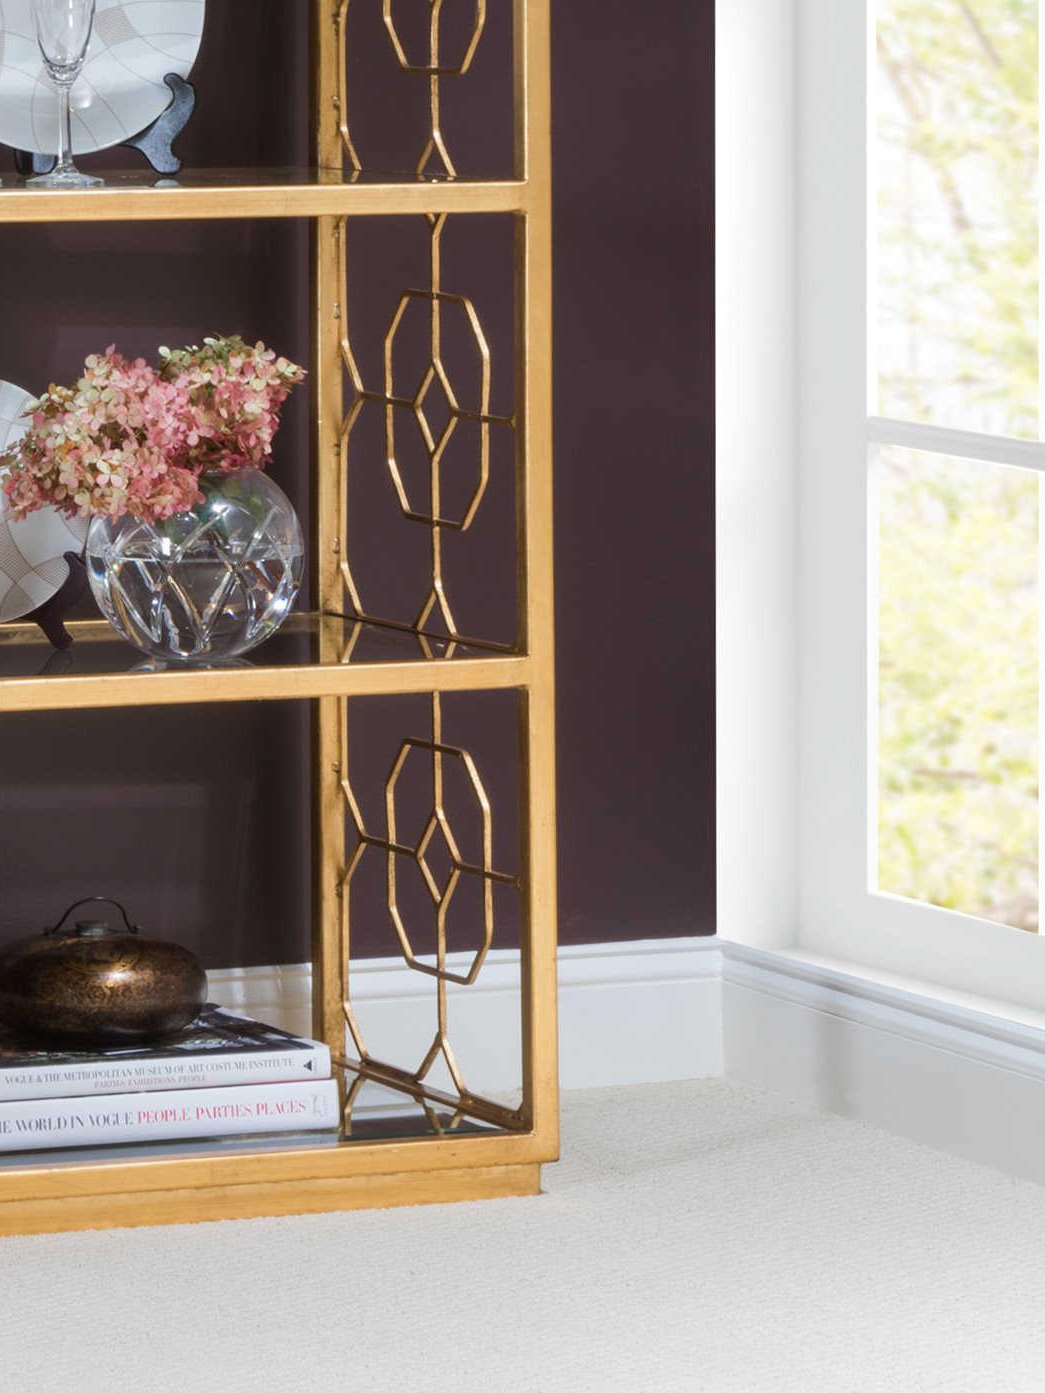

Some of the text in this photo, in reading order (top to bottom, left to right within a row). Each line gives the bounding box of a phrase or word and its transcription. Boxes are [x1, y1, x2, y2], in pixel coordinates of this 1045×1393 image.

[5, 1075, 35, 1085] VOGUE
[44, 1072, 61, 1083] THE
[63, 1068, 132, 1081] METROPOLITAN
[134, 1064, 172, 1077] MUSEUM
[173, 1063, 185, 1073] OF
[188, 1063, 205, 1073] ART
[206, 1060, 248, 1072] COSTUME
[249, 1057, 293, 1069] INSTITUTE
[14, 1116, 68, 1132] WORLD
[70, 1114, 86, 1128] IN
[88, 1111, 134, 1126] VOGUE
[137, 1108, 192, 1124] PEOPLE
[196, 1103, 253, 1121] PARTIES
[256, 1100, 306, 1116] PLACES
